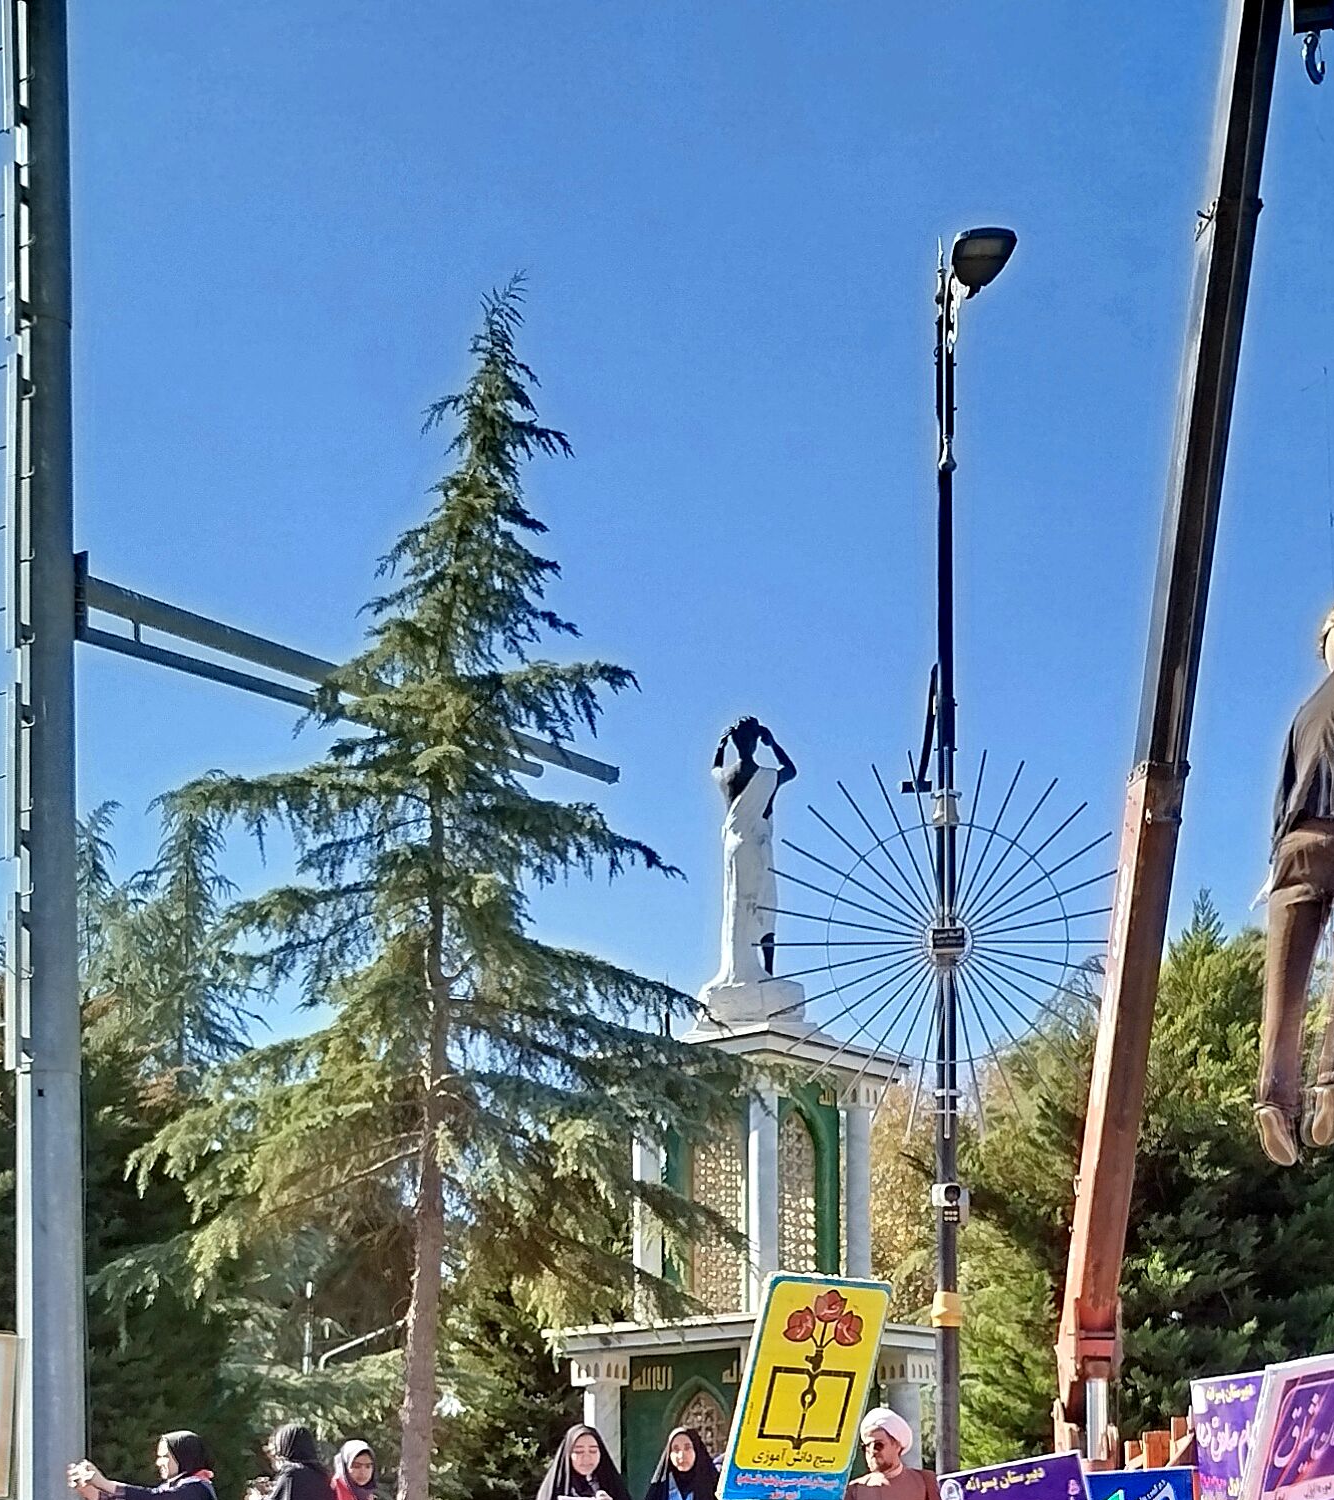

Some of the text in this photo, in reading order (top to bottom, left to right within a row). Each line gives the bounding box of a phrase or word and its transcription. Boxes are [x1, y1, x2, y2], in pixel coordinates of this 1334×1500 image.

[752, 1448, 836, 1468] بسیج دانش آموزی
[999, 1467, 1045, 1489] دبیرستان
